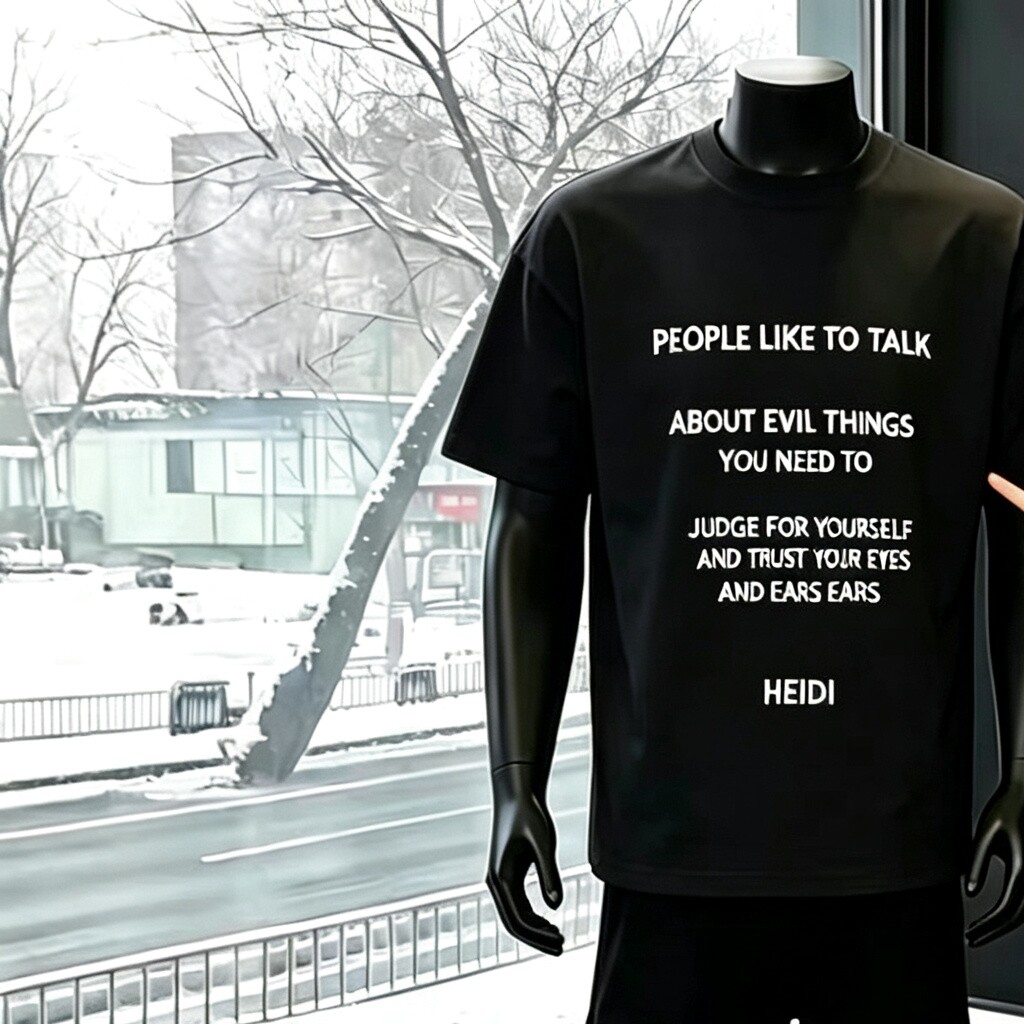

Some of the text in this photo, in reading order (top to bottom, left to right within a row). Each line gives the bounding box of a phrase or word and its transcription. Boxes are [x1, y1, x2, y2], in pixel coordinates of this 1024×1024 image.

[652, 323, 932, 360] PEOPLE LIKE TO TALK
[668, 408, 915, 438] ABOUT EVIL THINGS
[718, 448, 873, 474] YOU NEED TO
[687, 515, 913, 541] JUDGE FOR YOURSELF
[696, 547, 742, 570] AND
[747, 547, 809, 569] TRUST
[866, 548, 911, 571] EYES
[717, 580, 881, 604] AND EARS EARS
[763, 678, 835, 706] HEIDI
